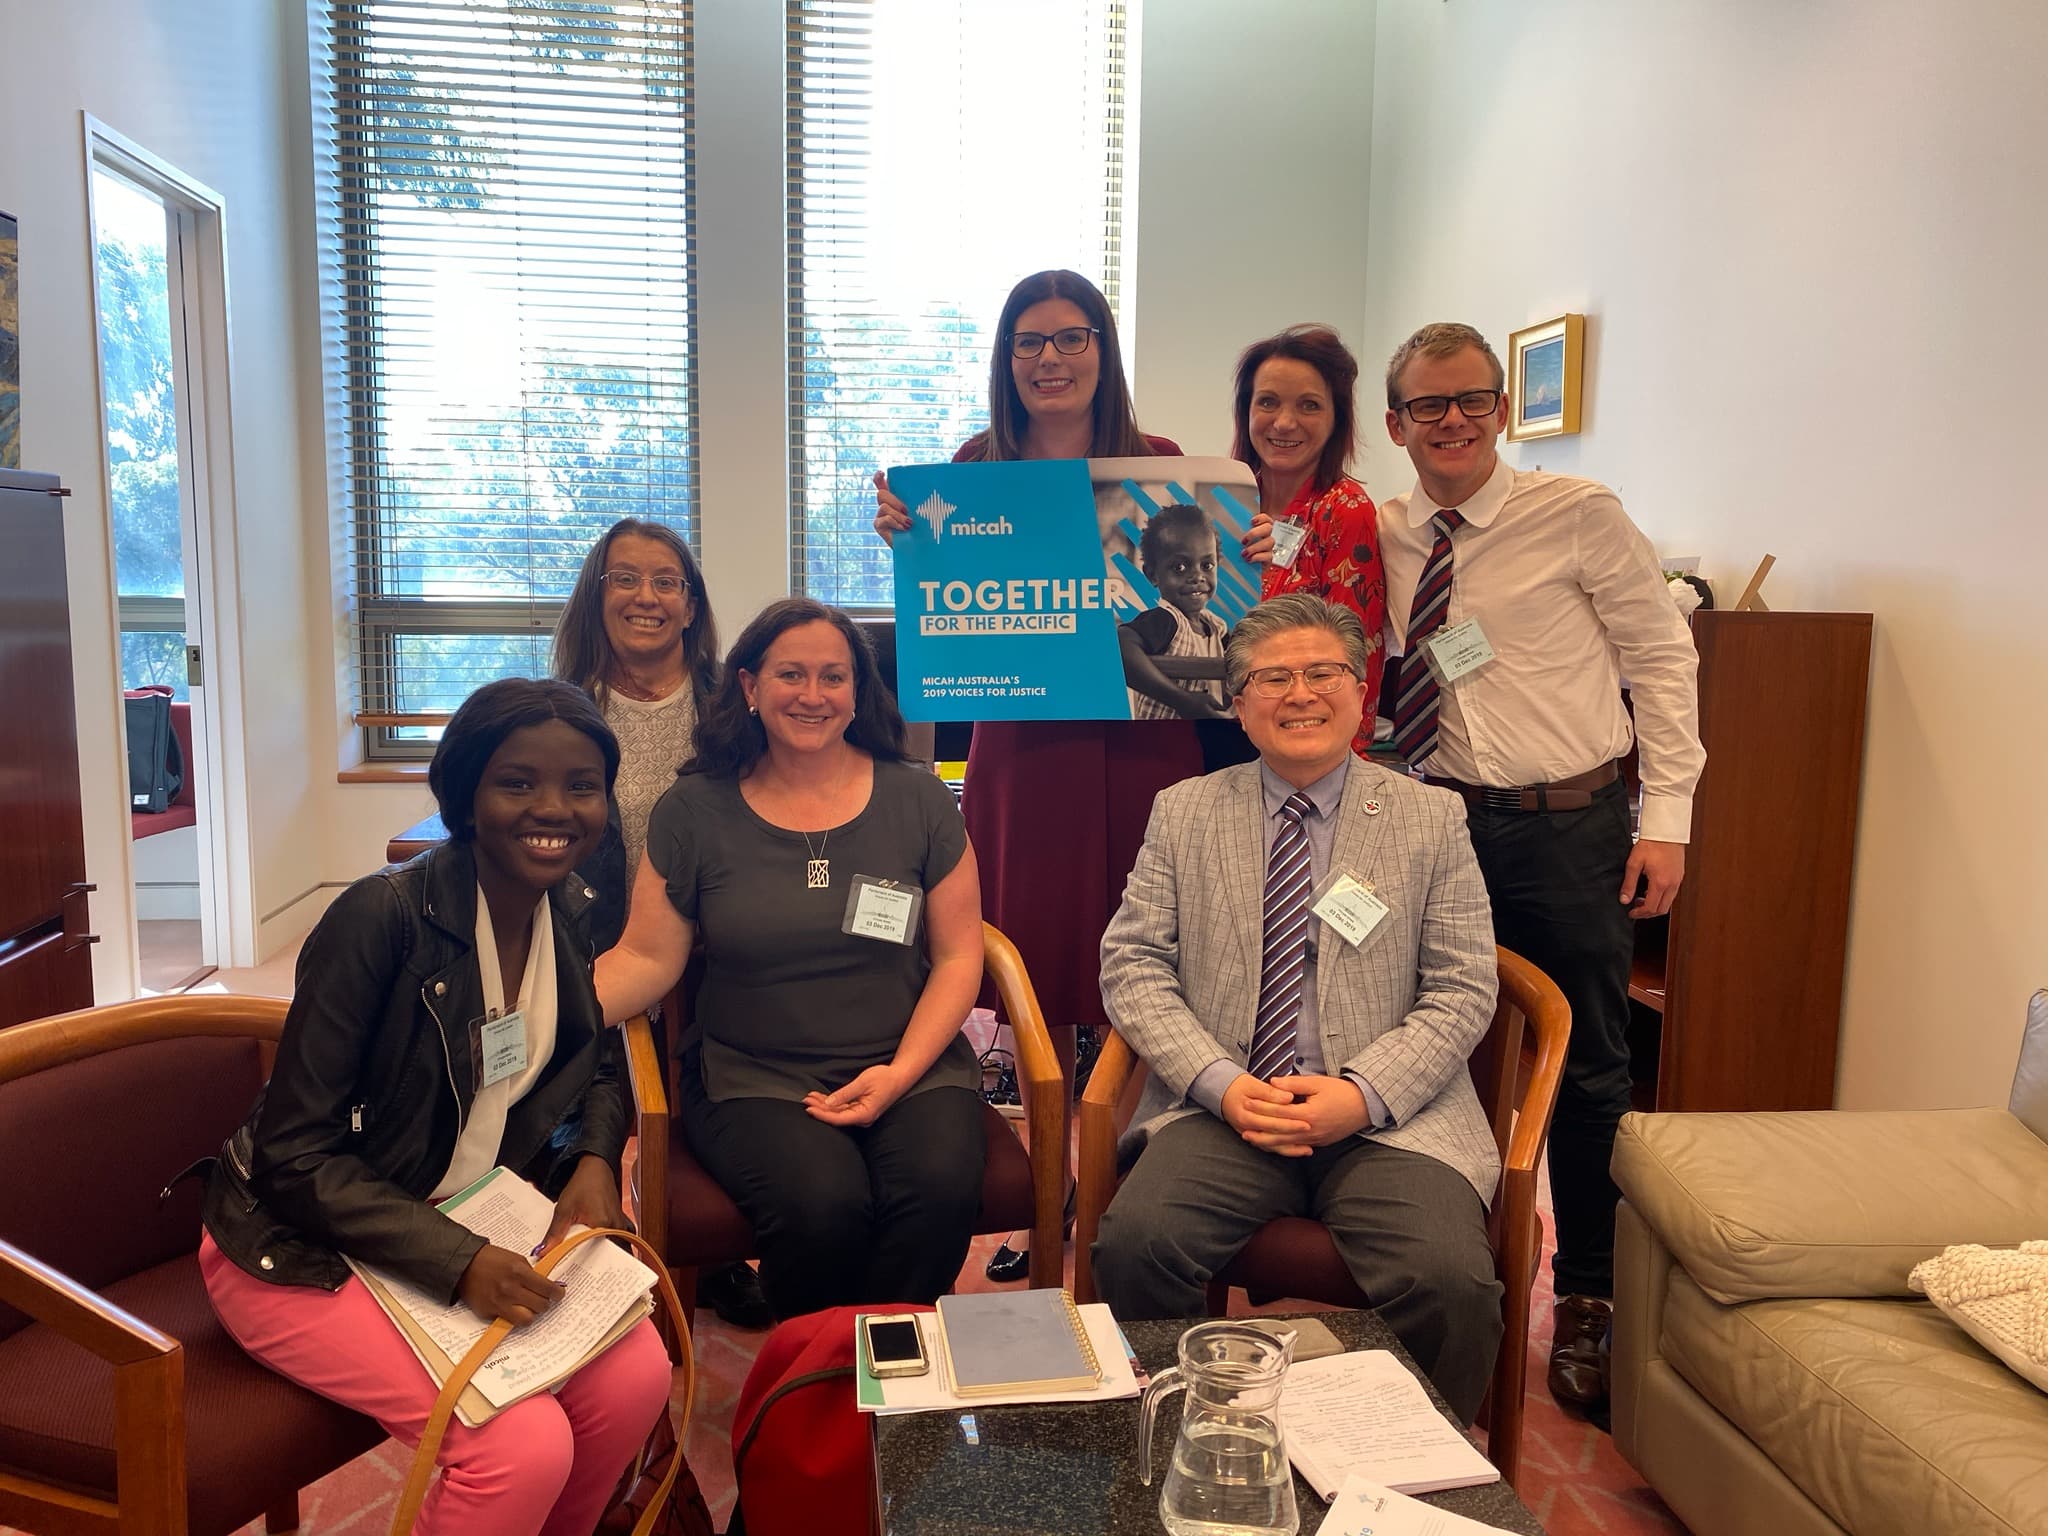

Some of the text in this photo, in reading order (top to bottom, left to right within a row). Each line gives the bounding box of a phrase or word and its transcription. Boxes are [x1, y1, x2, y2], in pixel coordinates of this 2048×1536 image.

[951, 515, 1013, 536] micah
[919, 578, 1129, 612] TOGETHER
[925, 614, 1071, 631] FOR THE PACIFIC
[922, 675, 1020, 686] MICAH AUSTRALIA'S
[923, 687, 1047, 698] 2019 VOICES FOR JUSTICE
[484, 1354, 511, 1370] micah
